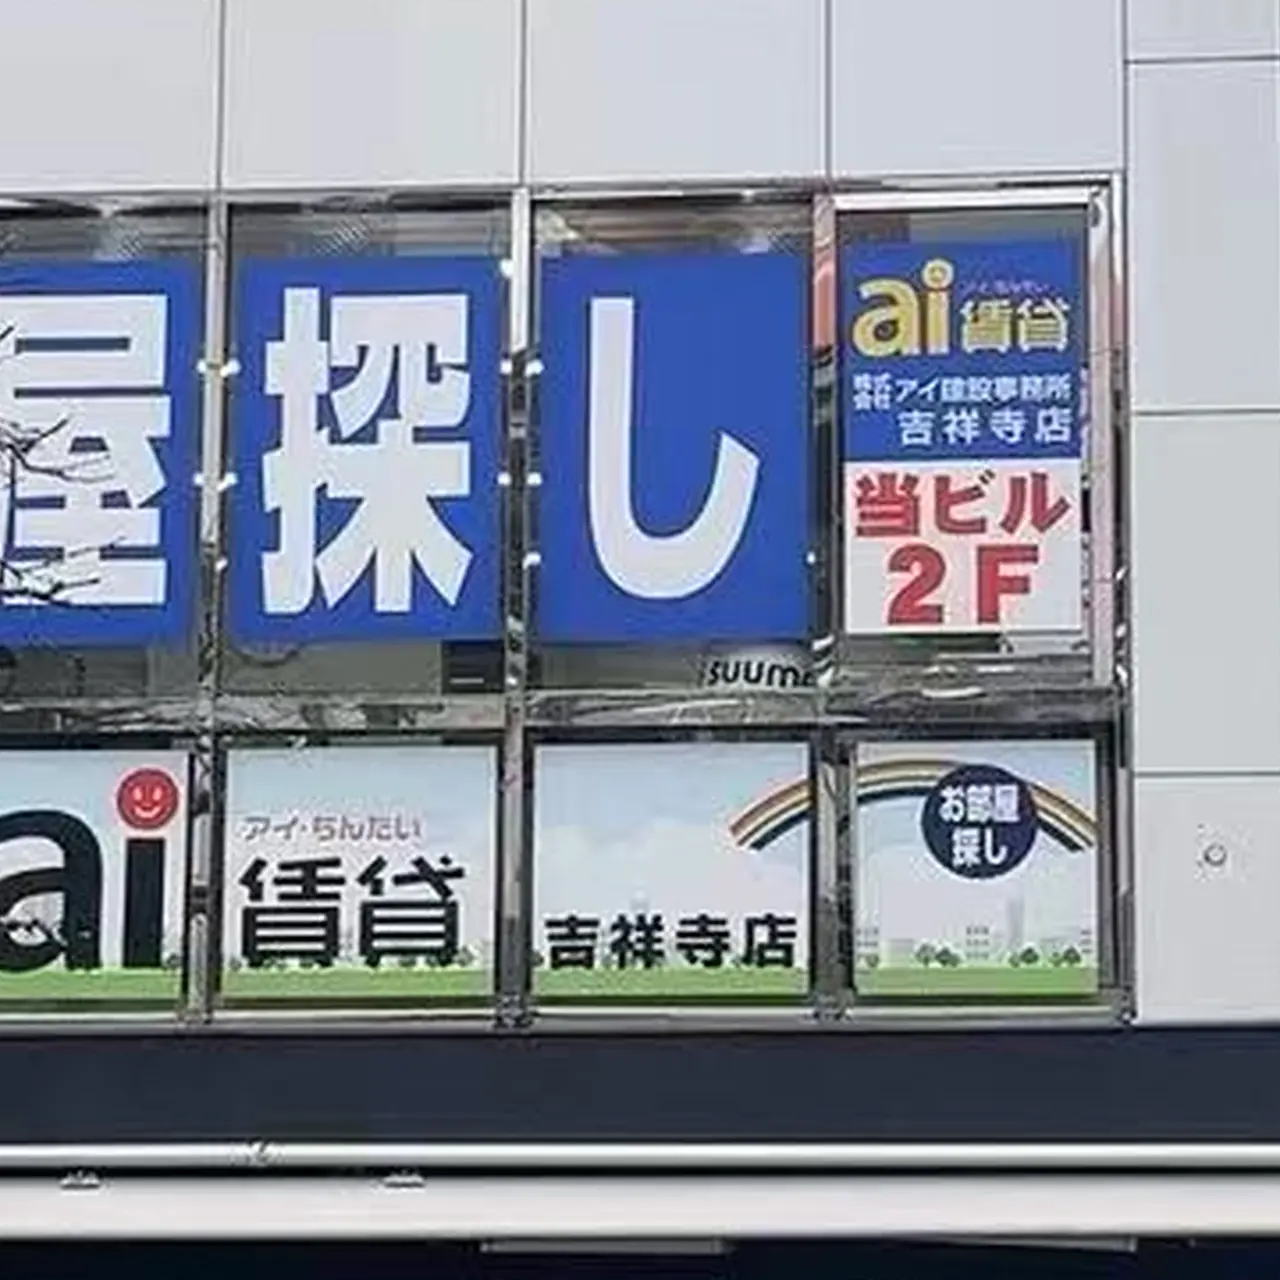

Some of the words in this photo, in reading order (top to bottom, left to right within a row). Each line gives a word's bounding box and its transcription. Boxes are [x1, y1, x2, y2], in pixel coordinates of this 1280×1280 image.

[852, 258, 955, 357] ai
[960, 298, 1071, 354] 賃貸
[898, 407, 1073, 447] 吉祥寺店
[855, 469, 1071, 538] 当ビル
[887, 543, 1040, 626] 2F
[938, 784, 1021, 823] お部屋
[951, 826, 1010, 868] 探し
[239, 854, 465, 967] 賃貸
[546, 913, 800, 969] 吉祥寺店
